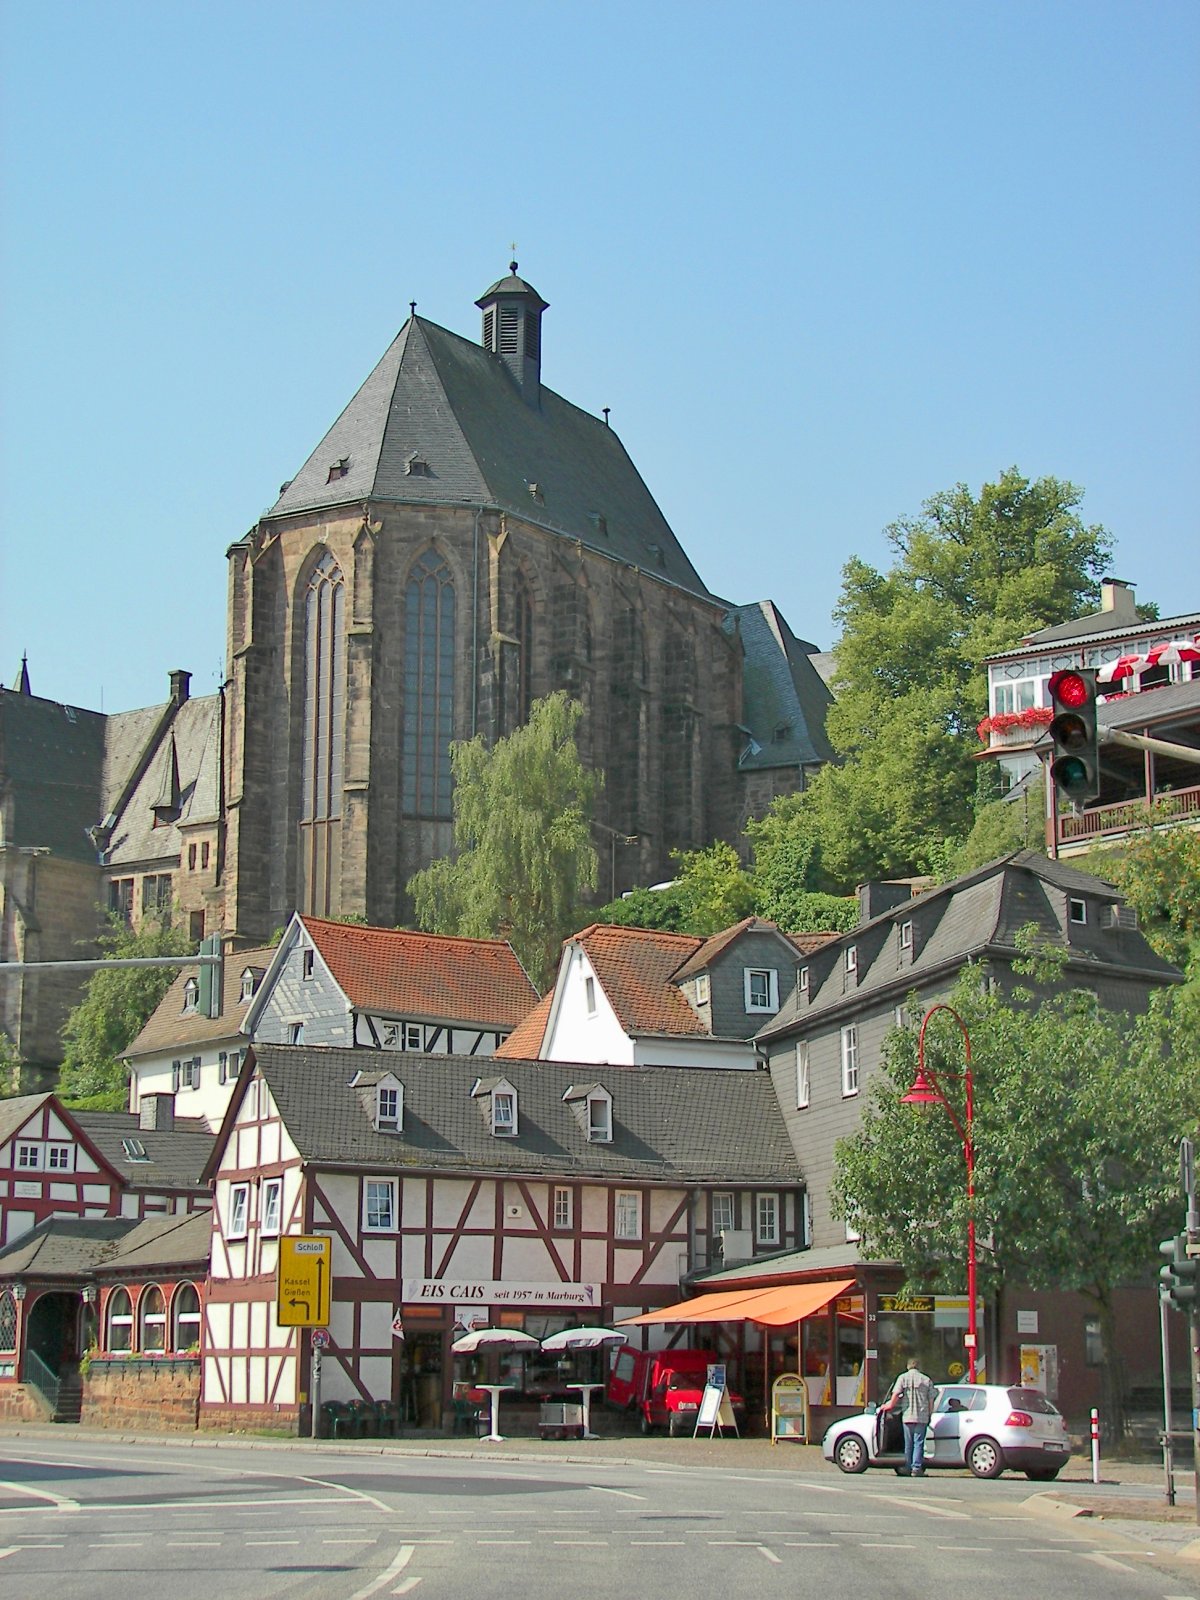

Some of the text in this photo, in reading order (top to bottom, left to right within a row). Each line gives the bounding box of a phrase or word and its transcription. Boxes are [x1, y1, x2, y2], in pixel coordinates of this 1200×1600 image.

[297, 1243, 323, 1251] Schloß
[284, 1278, 310, 1286] Kassel
[284, 1288, 311, 1296] Gießen
[421, 1284, 485, 1299] EIS CAIS
[493, 1290, 584, 1302] seit 1957 in Marburg
[893, 1299, 932, 1310] Müller
